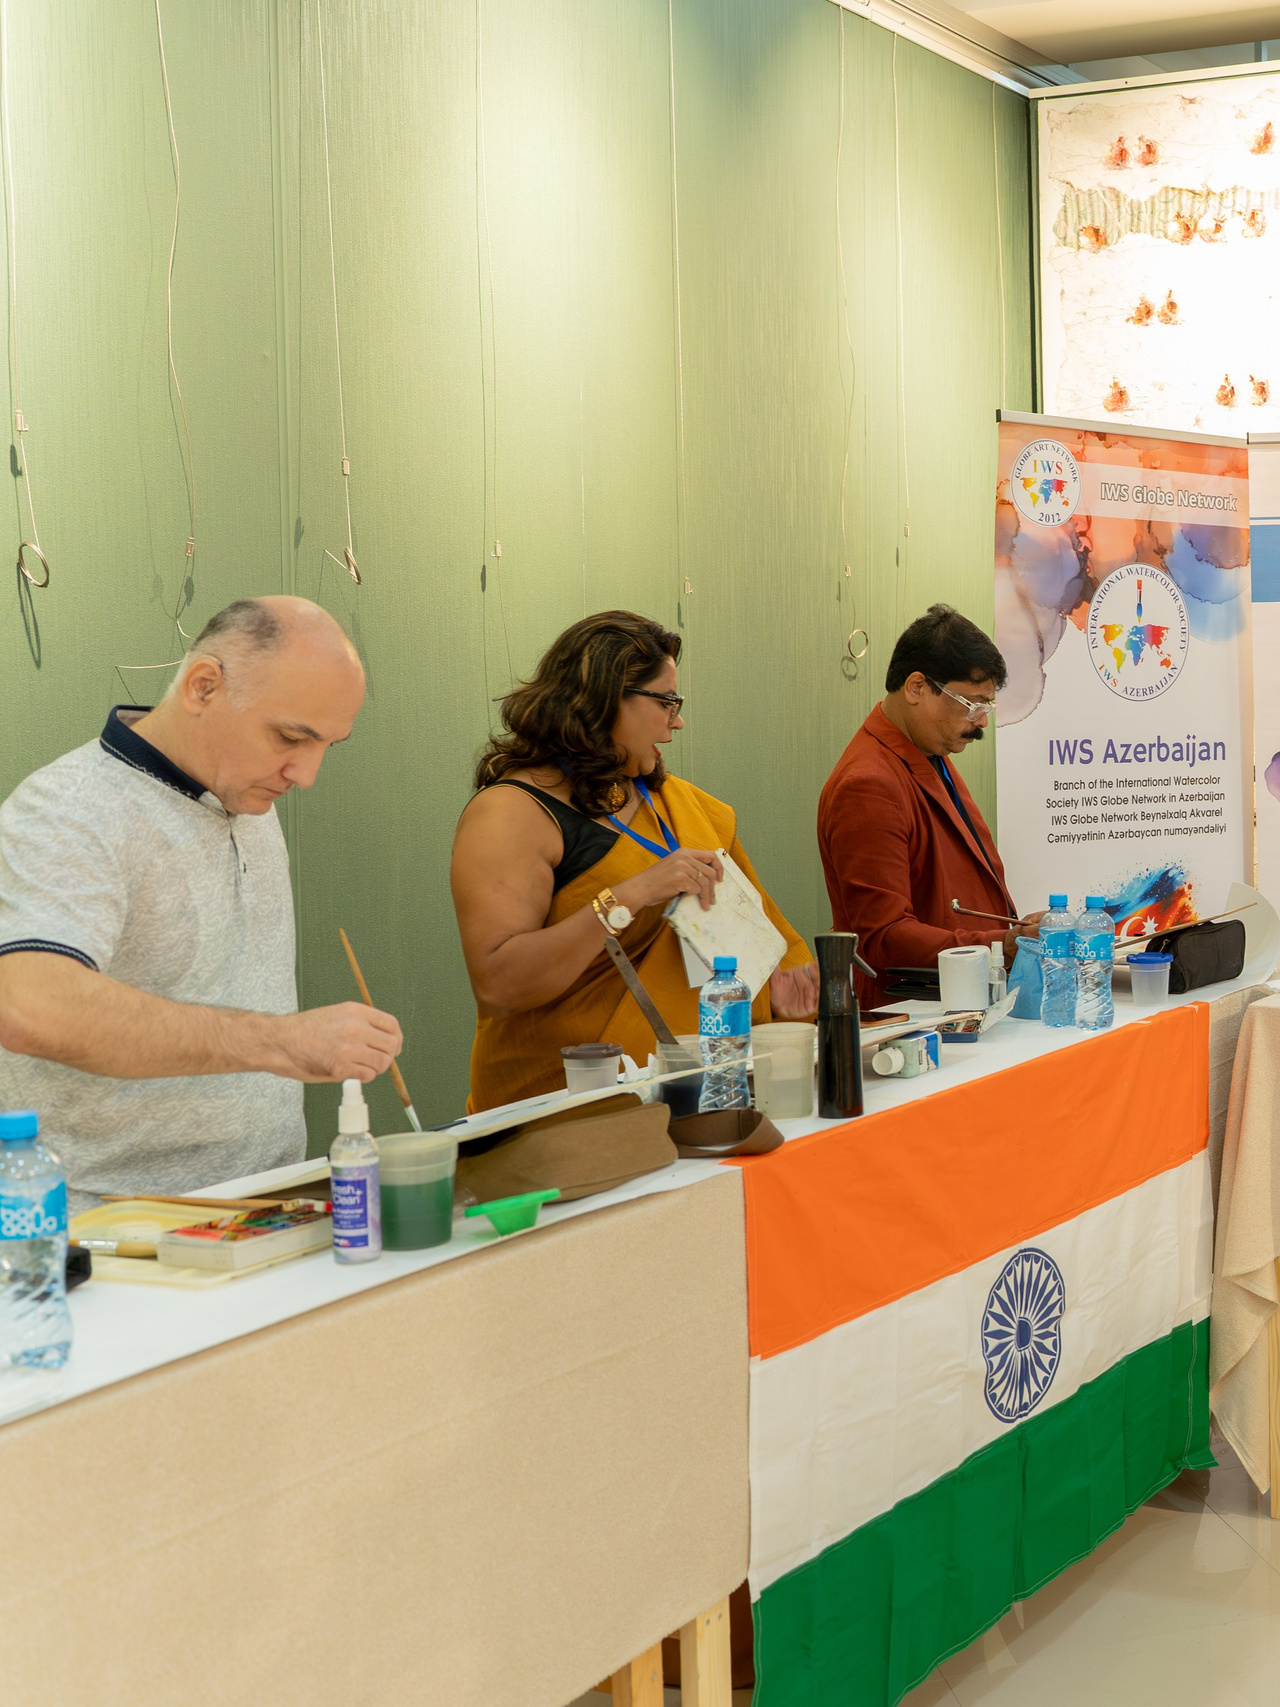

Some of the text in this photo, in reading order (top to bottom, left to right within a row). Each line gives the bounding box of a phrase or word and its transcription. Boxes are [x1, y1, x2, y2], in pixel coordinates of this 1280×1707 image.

[1015, 443, 1079, 483] GLOBE ART NETWORK
[1033, 459, 1063, 475] IWS
[1100, 482, 1237, 512] IWS Globe Network
[1038, 512, 1062, 523] 2012
[1090, 566, 1187, 653] INTERNATIONAL WATERCOLOR SOCIETY
[1099, 664, 1178, 697] IWS AZERBAIJAN
[1049, 734, 1226, 768] IWS Azerbaijan
[1054, 775, 1221, 791] Branch of the International Watercolor
[1046, 791, 1225, 809] Society IWS Globe Network in Azerbaijan
[1051, 807, 1223, 826] IWS Globe Network Beynəlxalq Akvarel
[1107, 828, 1162, 840] Azərbaycan
